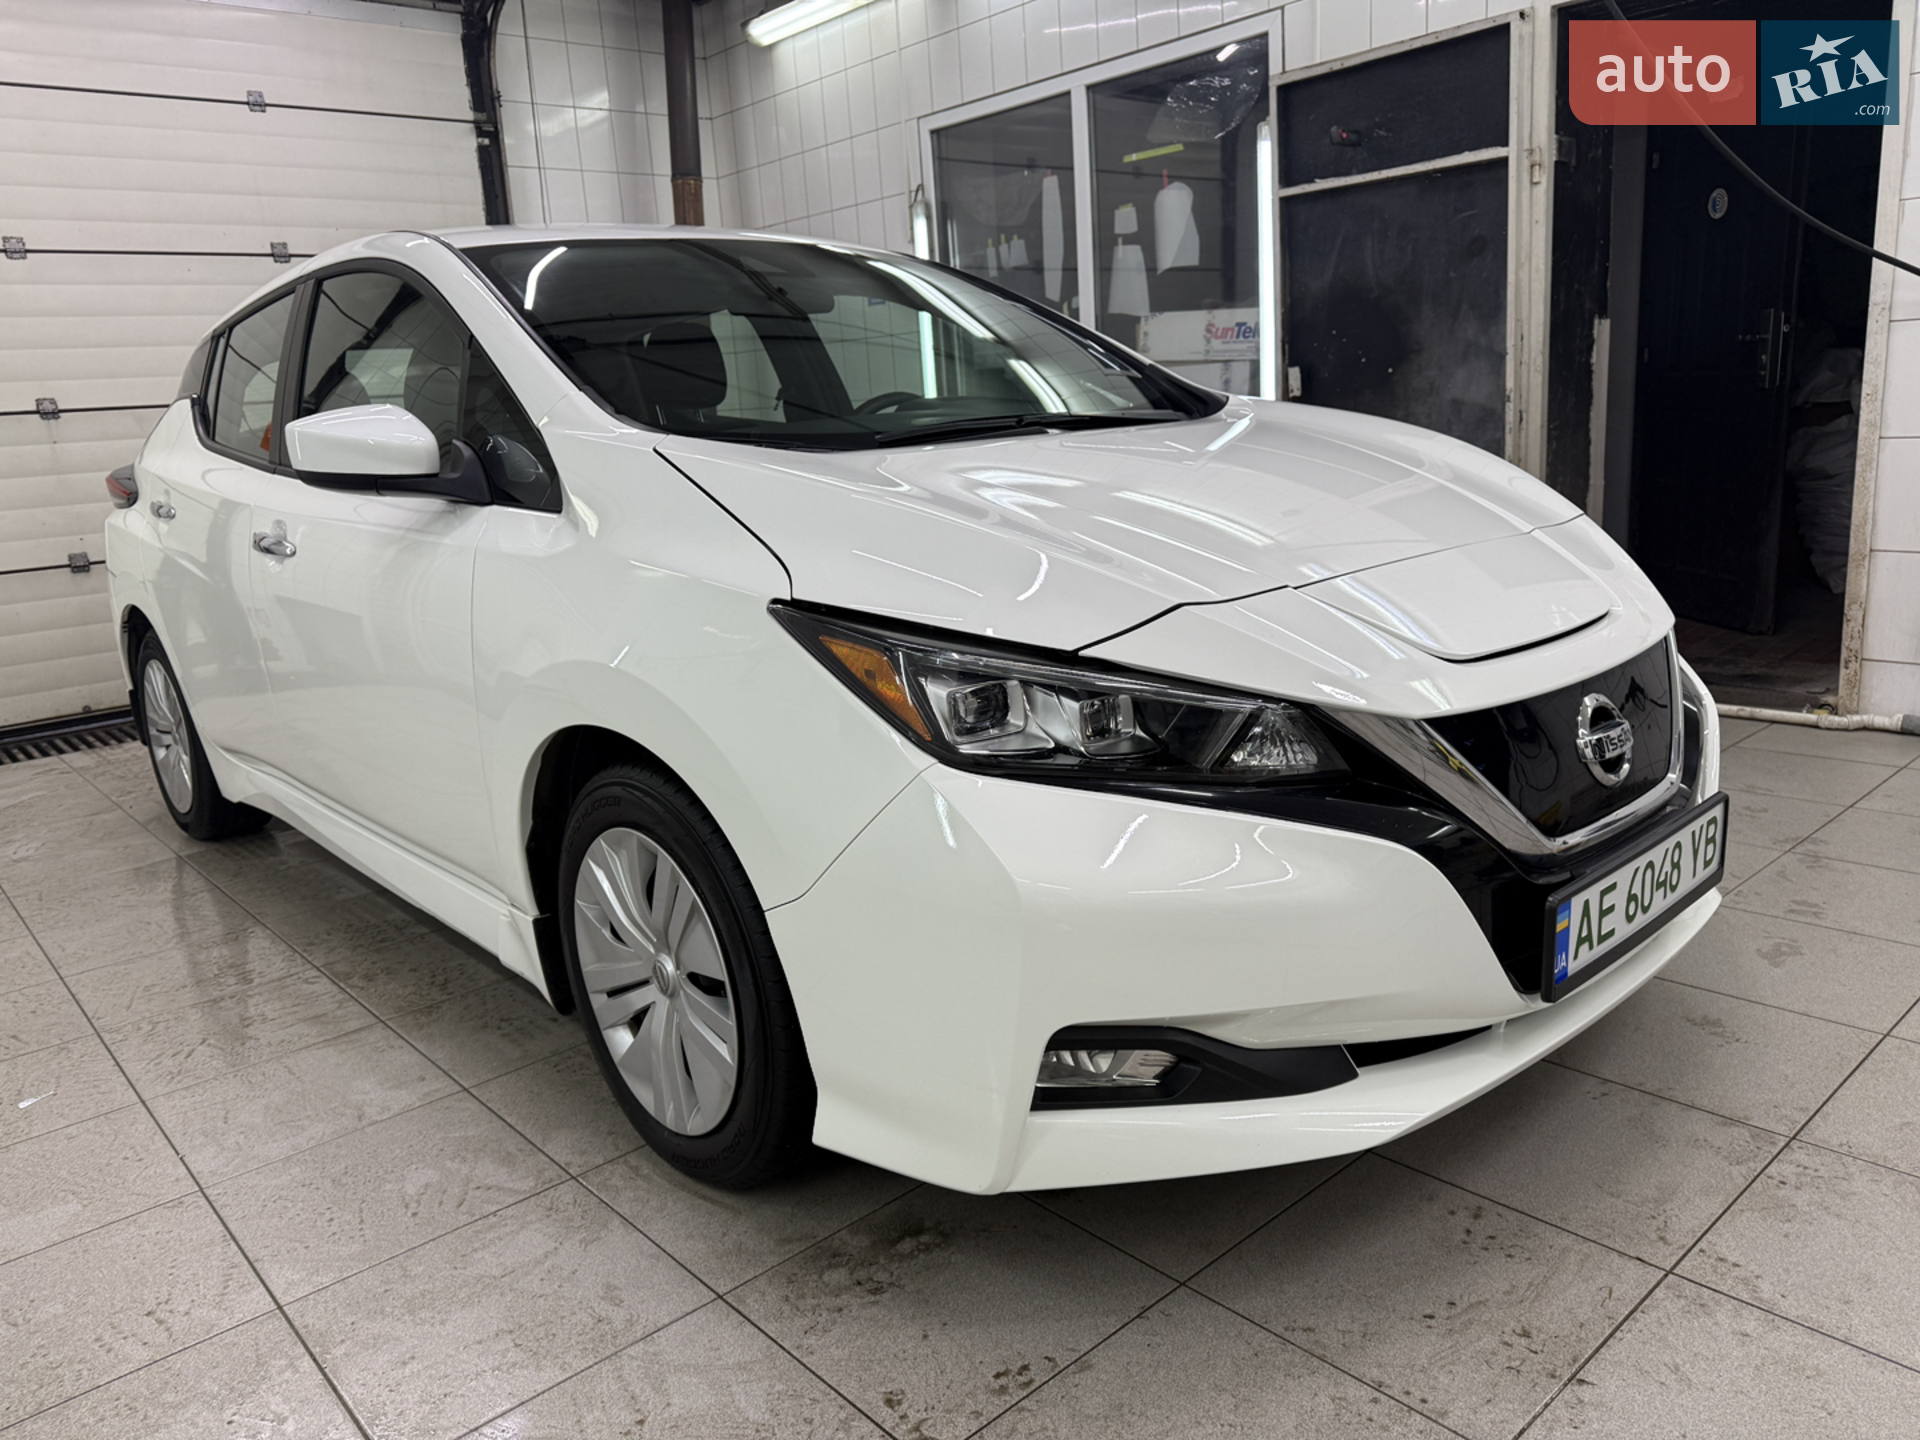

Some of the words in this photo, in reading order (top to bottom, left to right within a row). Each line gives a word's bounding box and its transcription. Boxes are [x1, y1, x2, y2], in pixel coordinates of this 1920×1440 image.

[1573, 881, 1617, 961] AE
[1625, 840, 1683, 924] 6048
[1691, 815, 1718, 879] YB
[1554, 951, 1567, 974] UA
